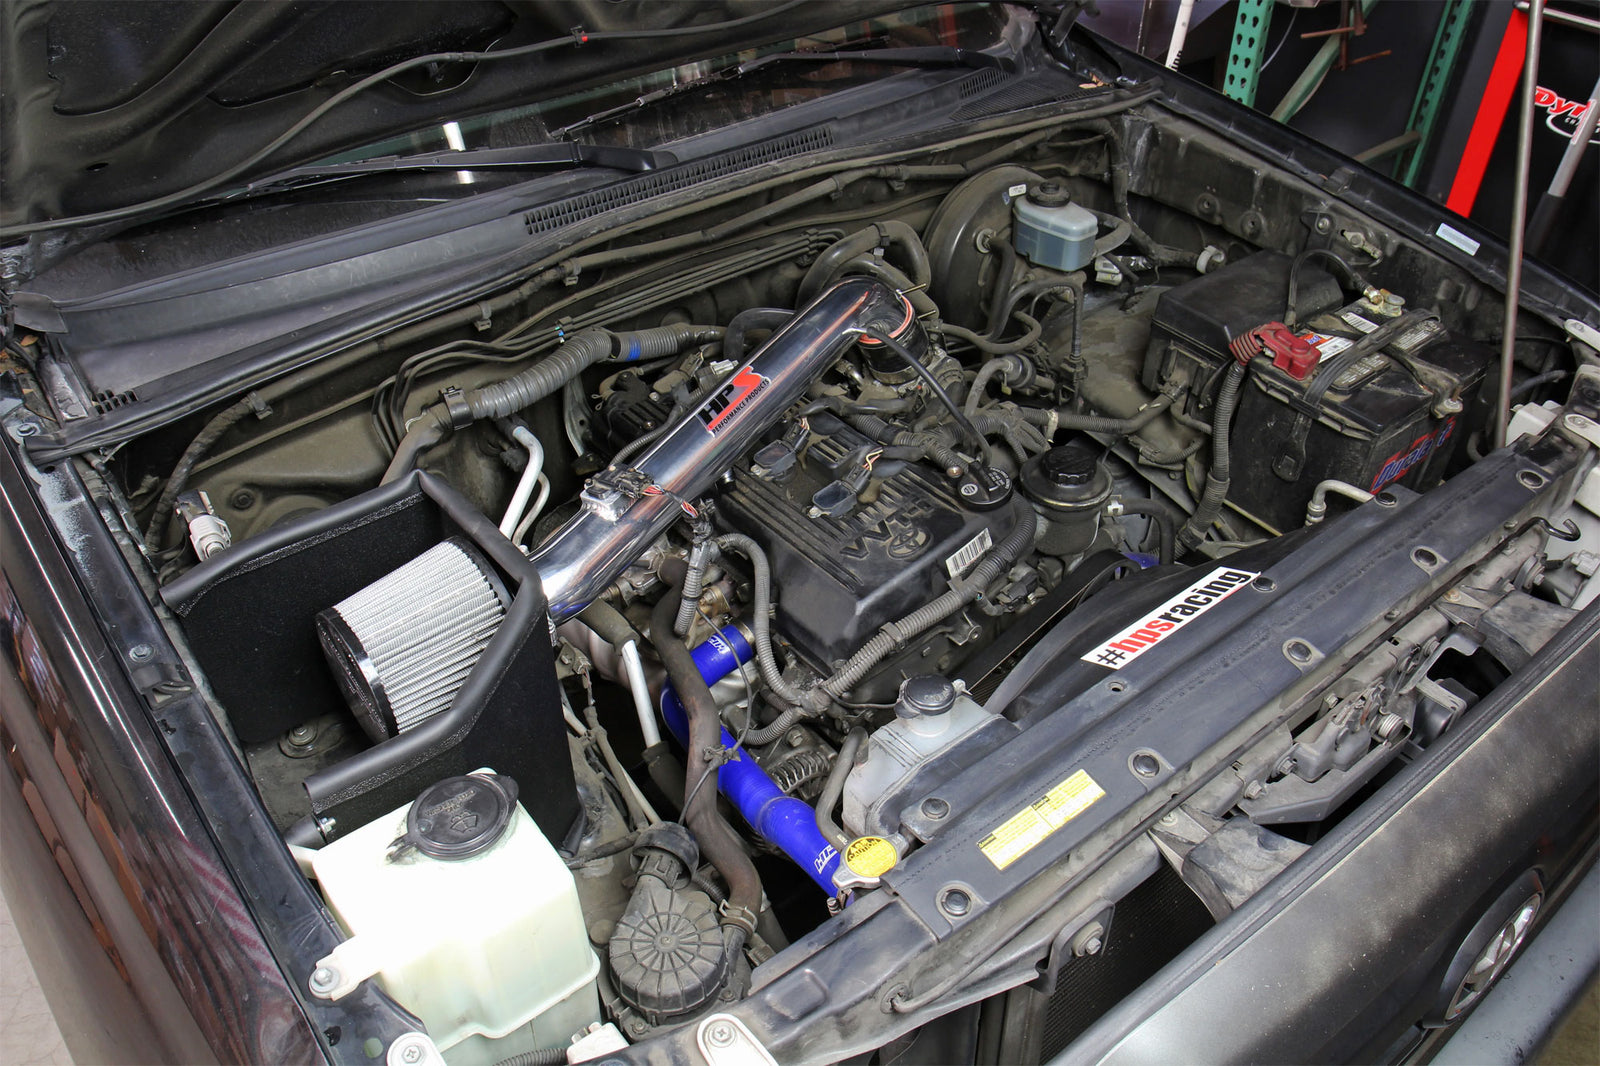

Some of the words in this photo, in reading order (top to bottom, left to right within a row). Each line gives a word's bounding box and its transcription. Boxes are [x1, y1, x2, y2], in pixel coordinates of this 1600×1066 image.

[698, 366, 761, 431] HPS
[712, 401, 747, 434] PERFORMANCE
[745, 379, 770, 404] PRODUCTS
[1373, 421, 1454, 491] Duralat
[707, 634, 731, 655] HP
[1097, 571, 1251, 665] #hpsracing
[813, 844, 838, 875] HP
